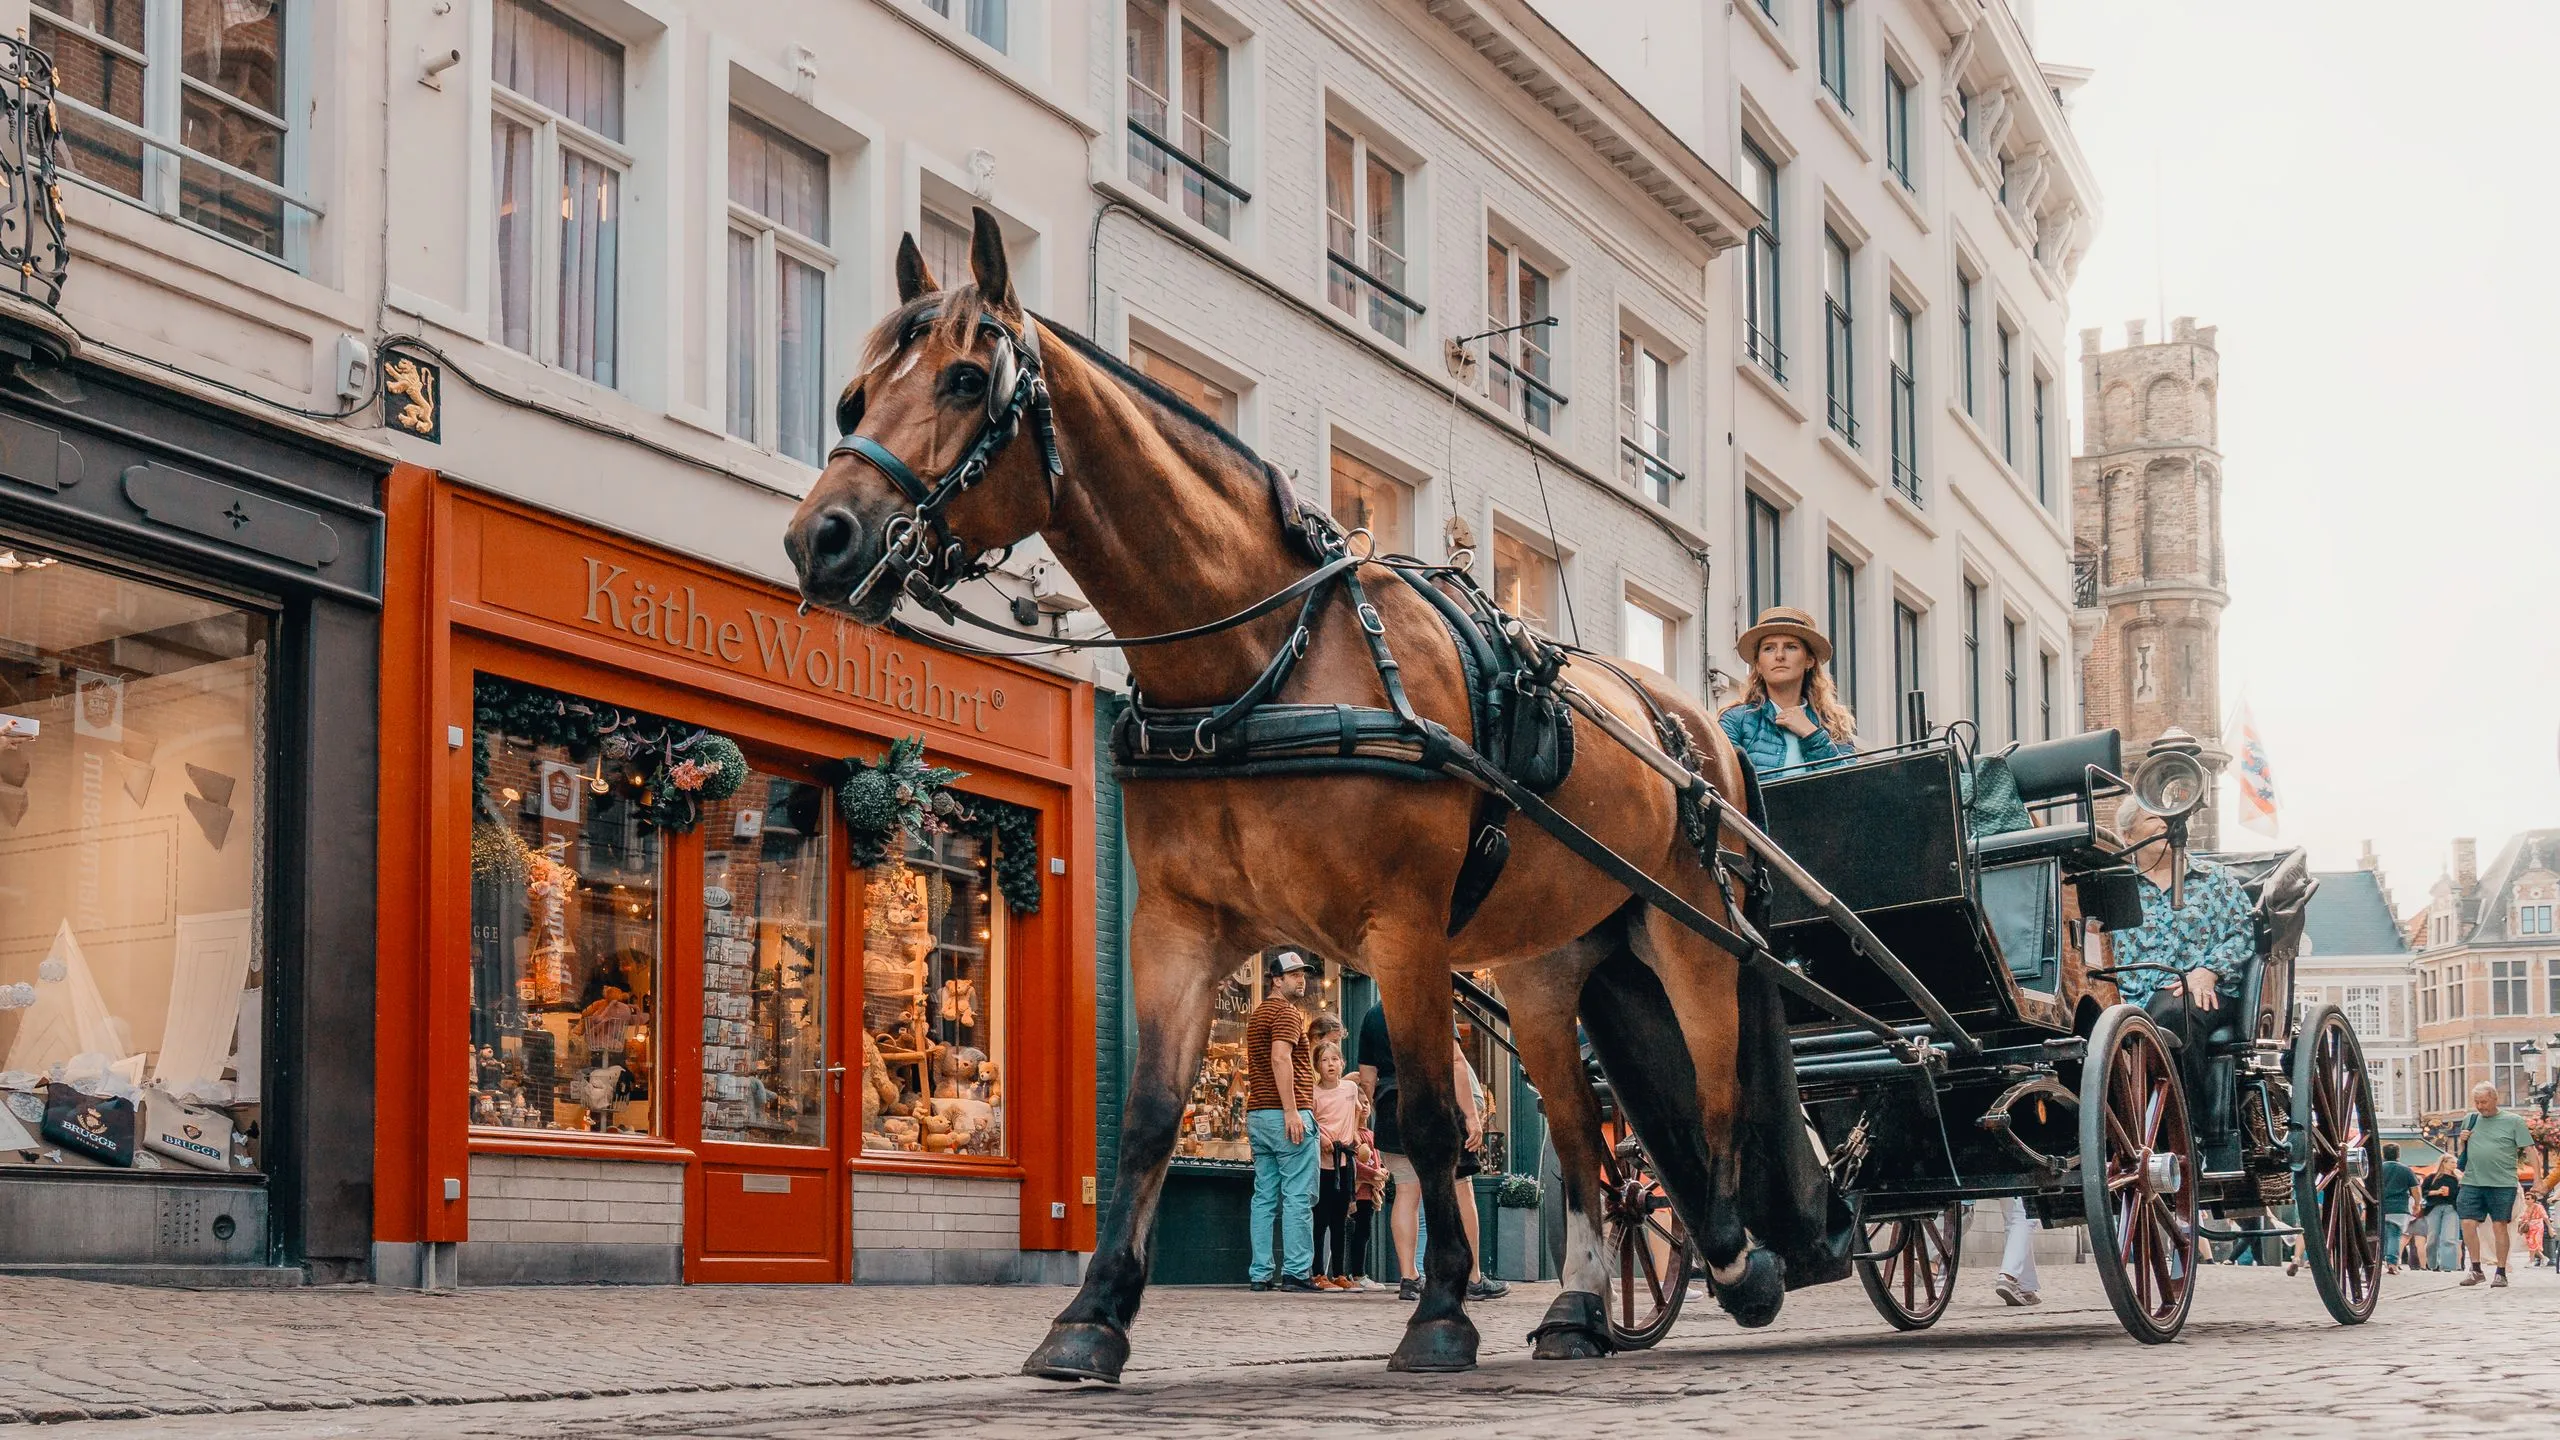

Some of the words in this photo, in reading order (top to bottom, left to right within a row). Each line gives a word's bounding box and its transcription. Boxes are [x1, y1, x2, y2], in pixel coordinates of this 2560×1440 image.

[582, 556, 745, 664] Käthe
[61, 1120, 117, 1151] BRUGGE
[165, 1135, 220, 1160] BRUGGE
